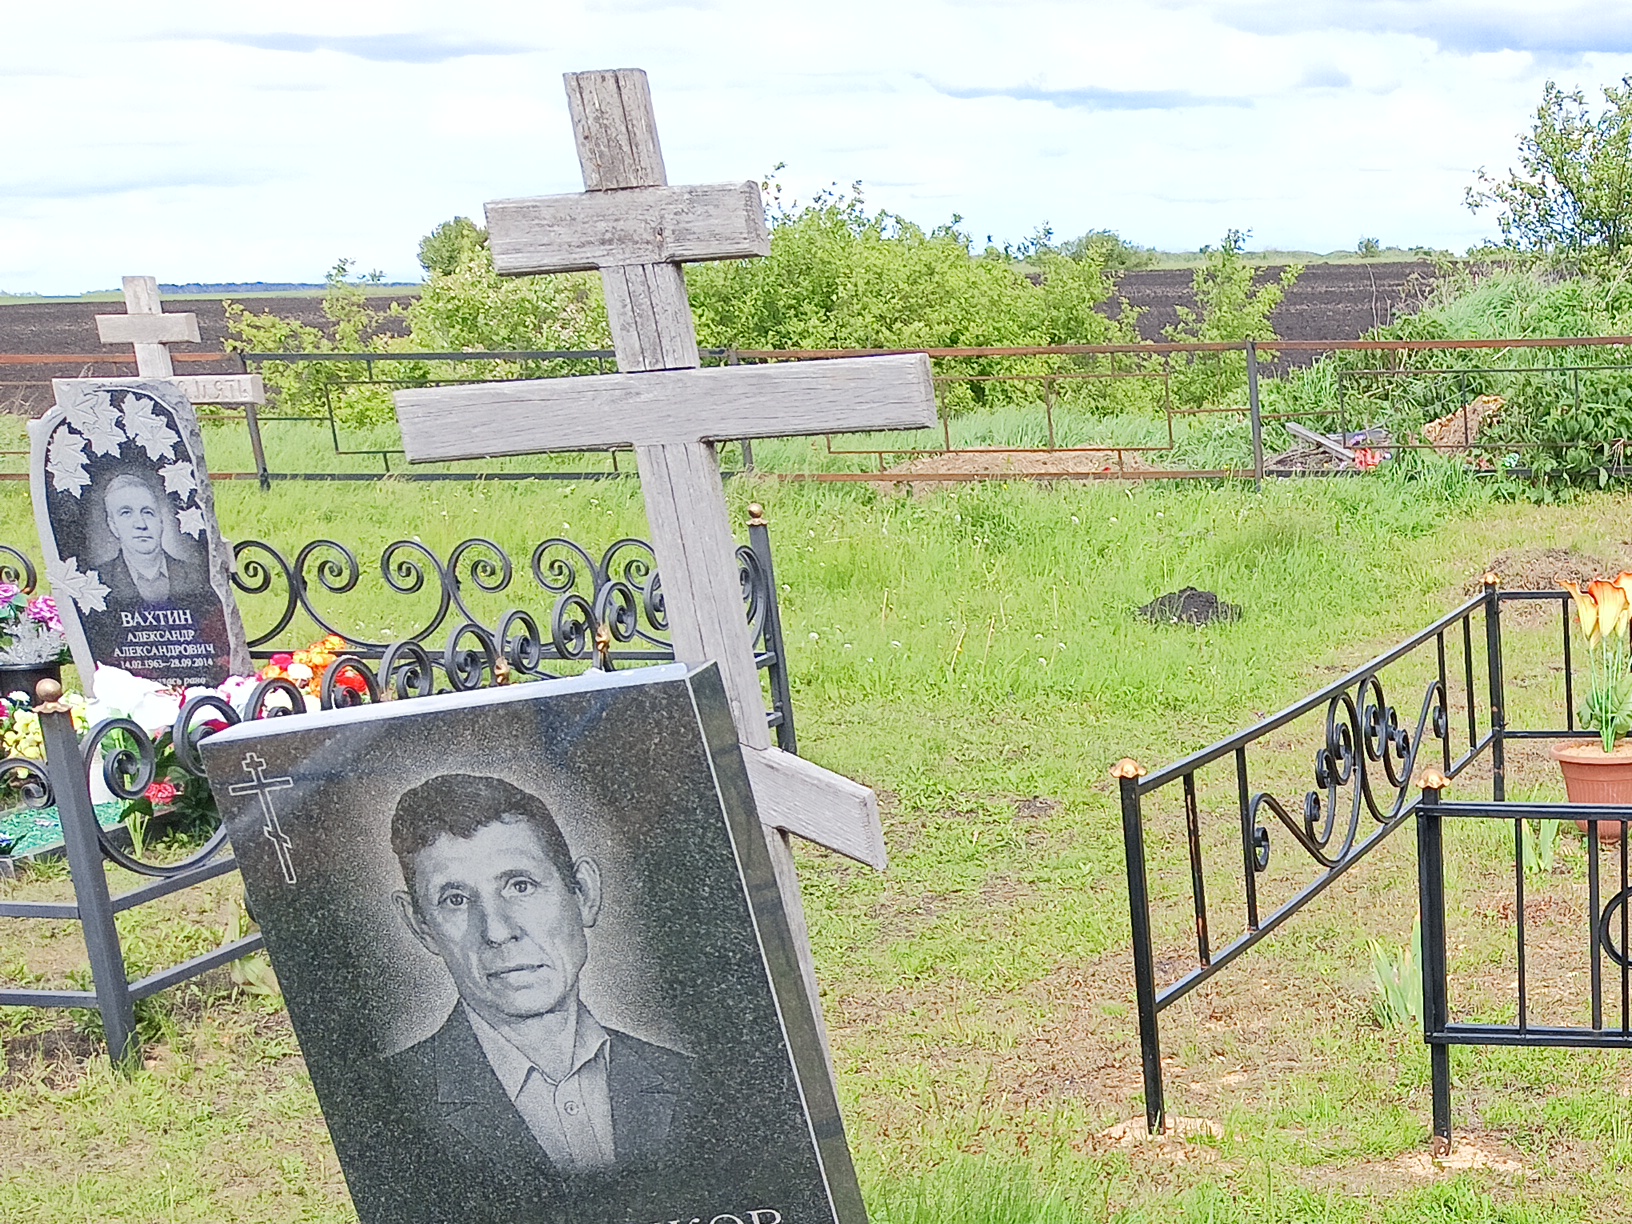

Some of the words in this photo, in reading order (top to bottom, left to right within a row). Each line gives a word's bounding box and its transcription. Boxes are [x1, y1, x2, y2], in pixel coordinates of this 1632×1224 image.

[120, 609, 193, 627] ВАХТИН
[127, 629, 195, 643] АЛЕКСАНДР
[114, 644, 216, 657] АЛЕКСАНДРОВИЧ
